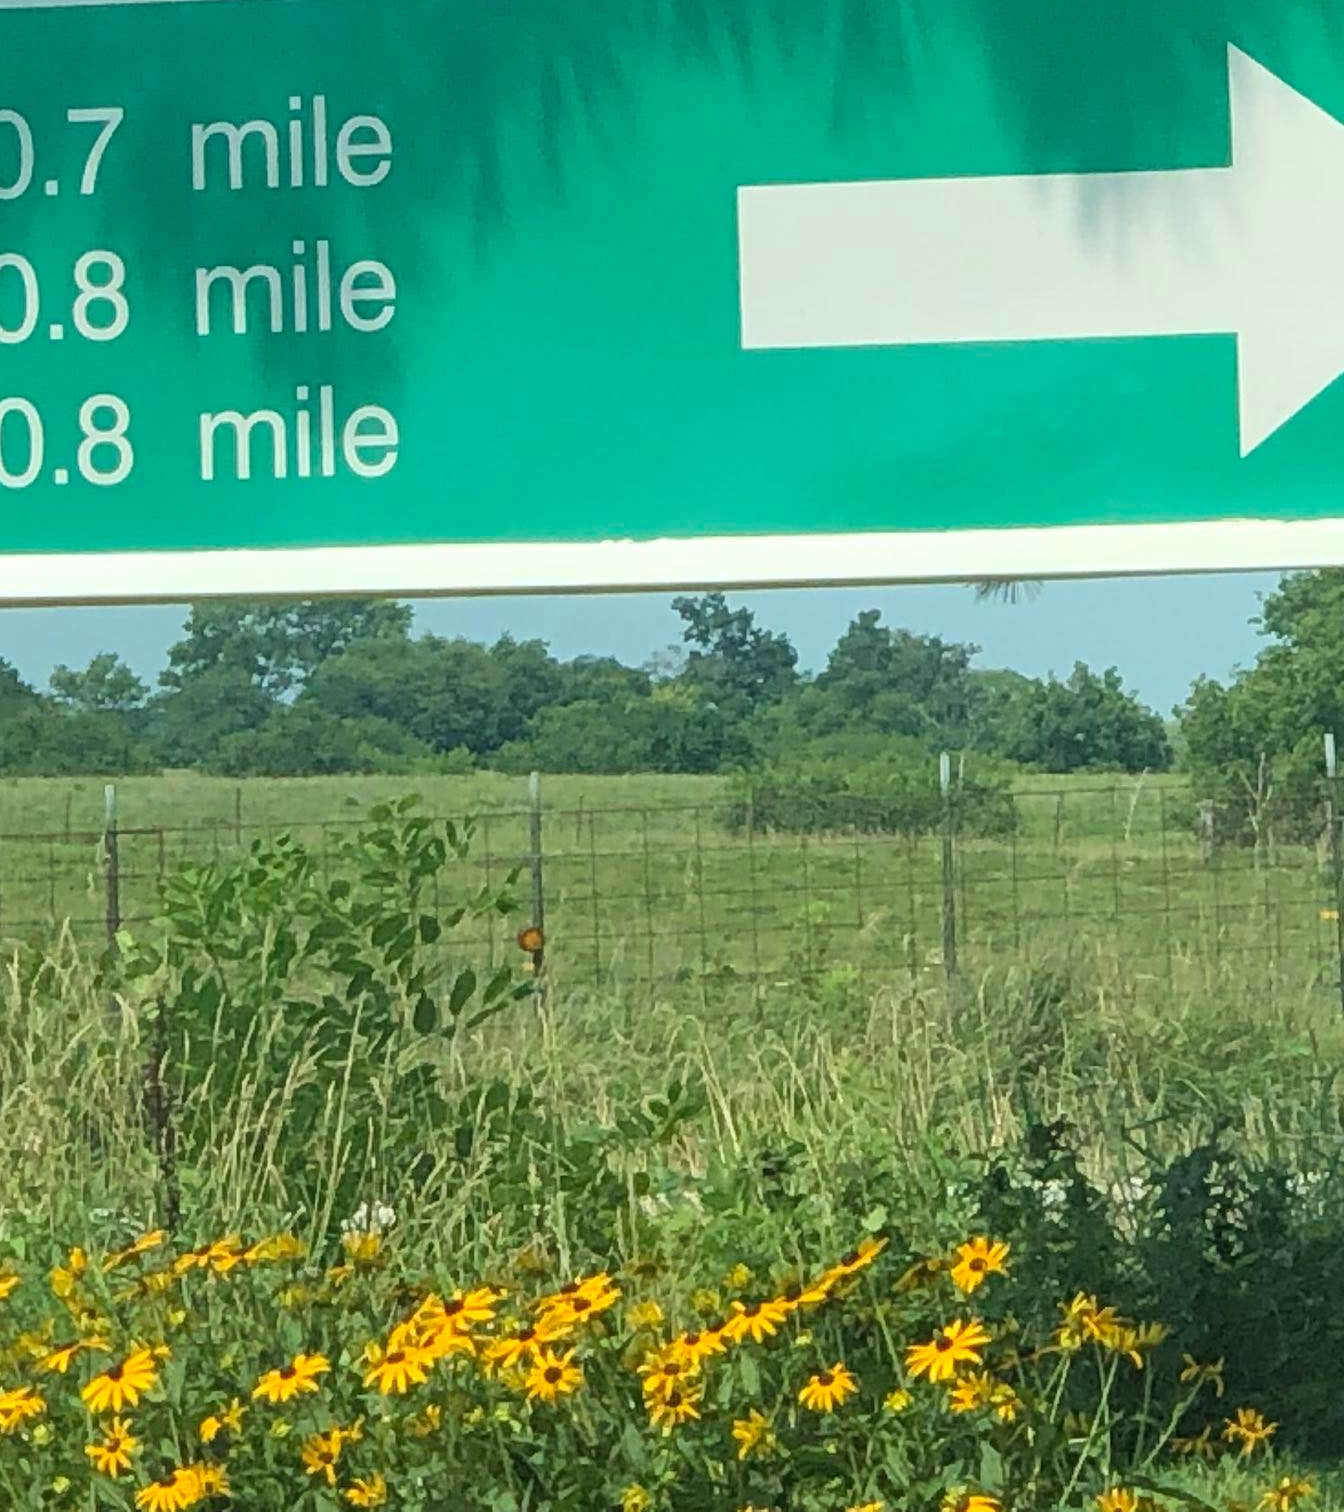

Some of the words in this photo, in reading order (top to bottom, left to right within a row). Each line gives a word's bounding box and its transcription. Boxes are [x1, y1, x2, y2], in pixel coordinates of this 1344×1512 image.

[191, 95, 392, 191] mile
[195, 240, 397, 336] mile
[199, 385, 400, 481] mile
